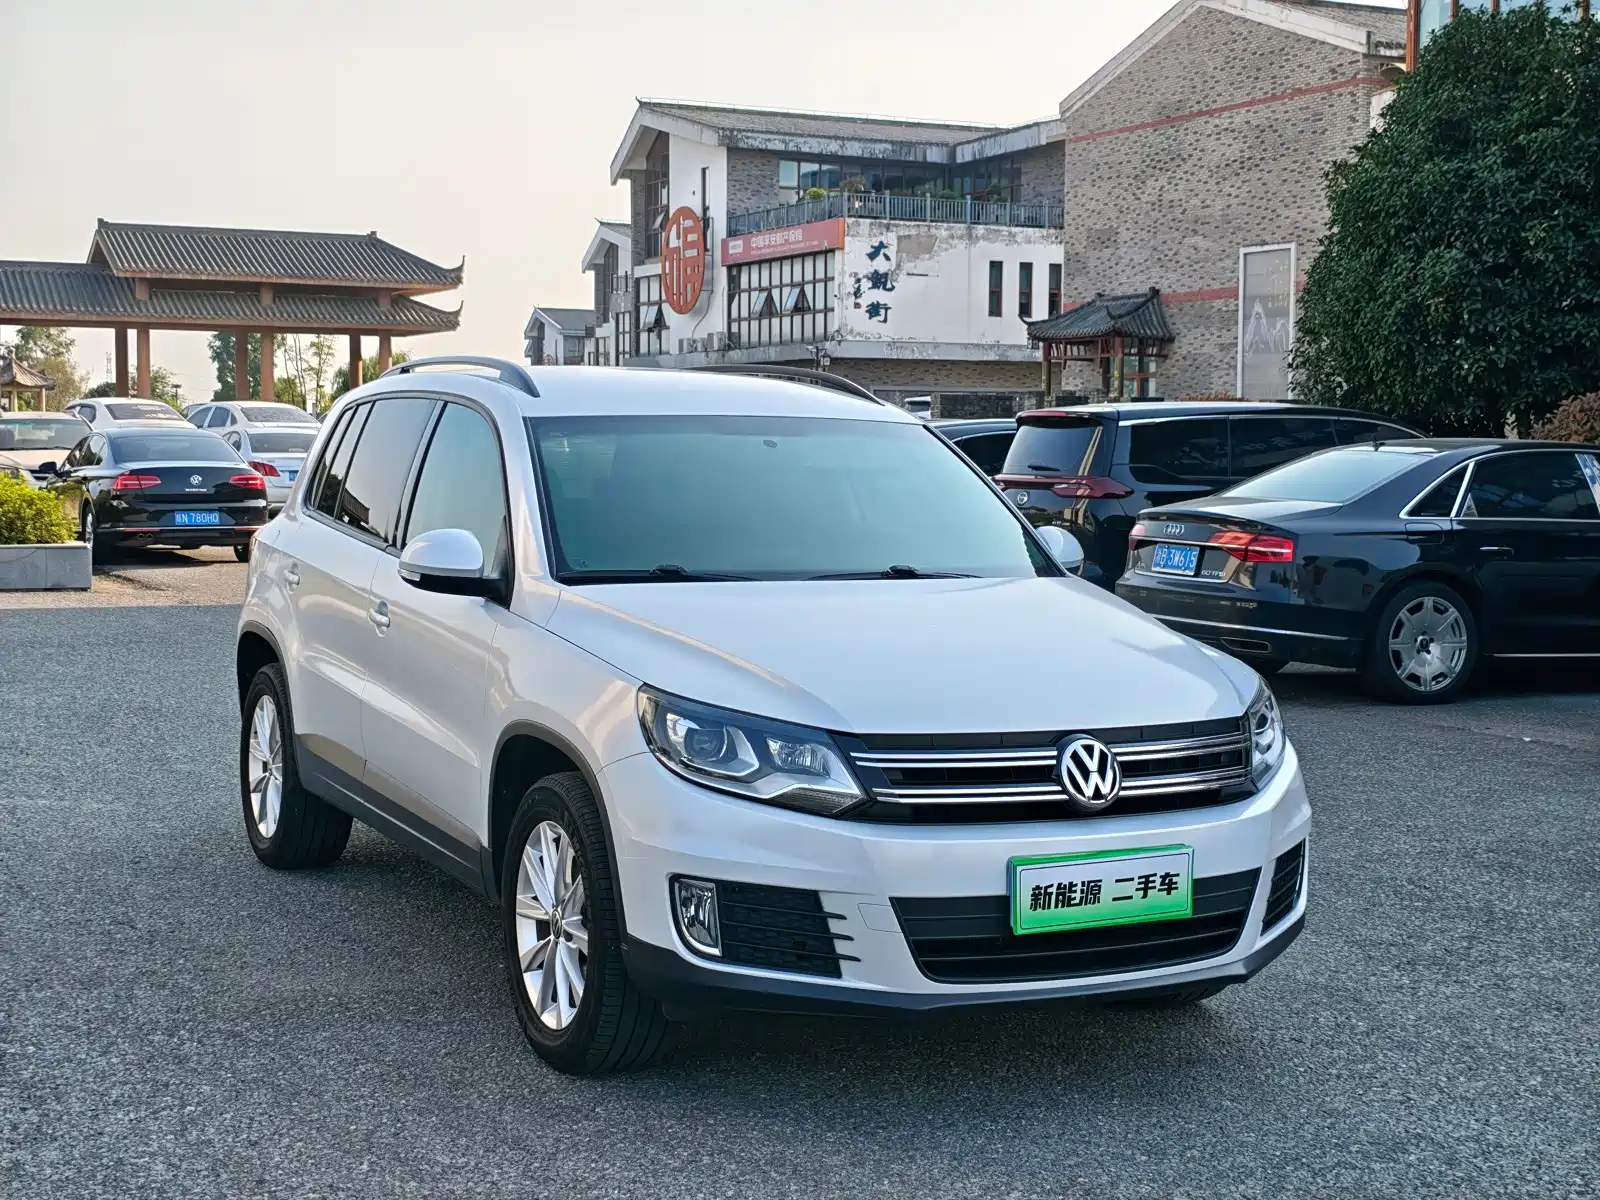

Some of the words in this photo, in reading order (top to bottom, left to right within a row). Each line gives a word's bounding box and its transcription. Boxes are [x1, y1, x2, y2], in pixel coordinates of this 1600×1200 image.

[1029, 879, 1103, 912] 新能源
[1111, 872, 1180, 903] 二手车
